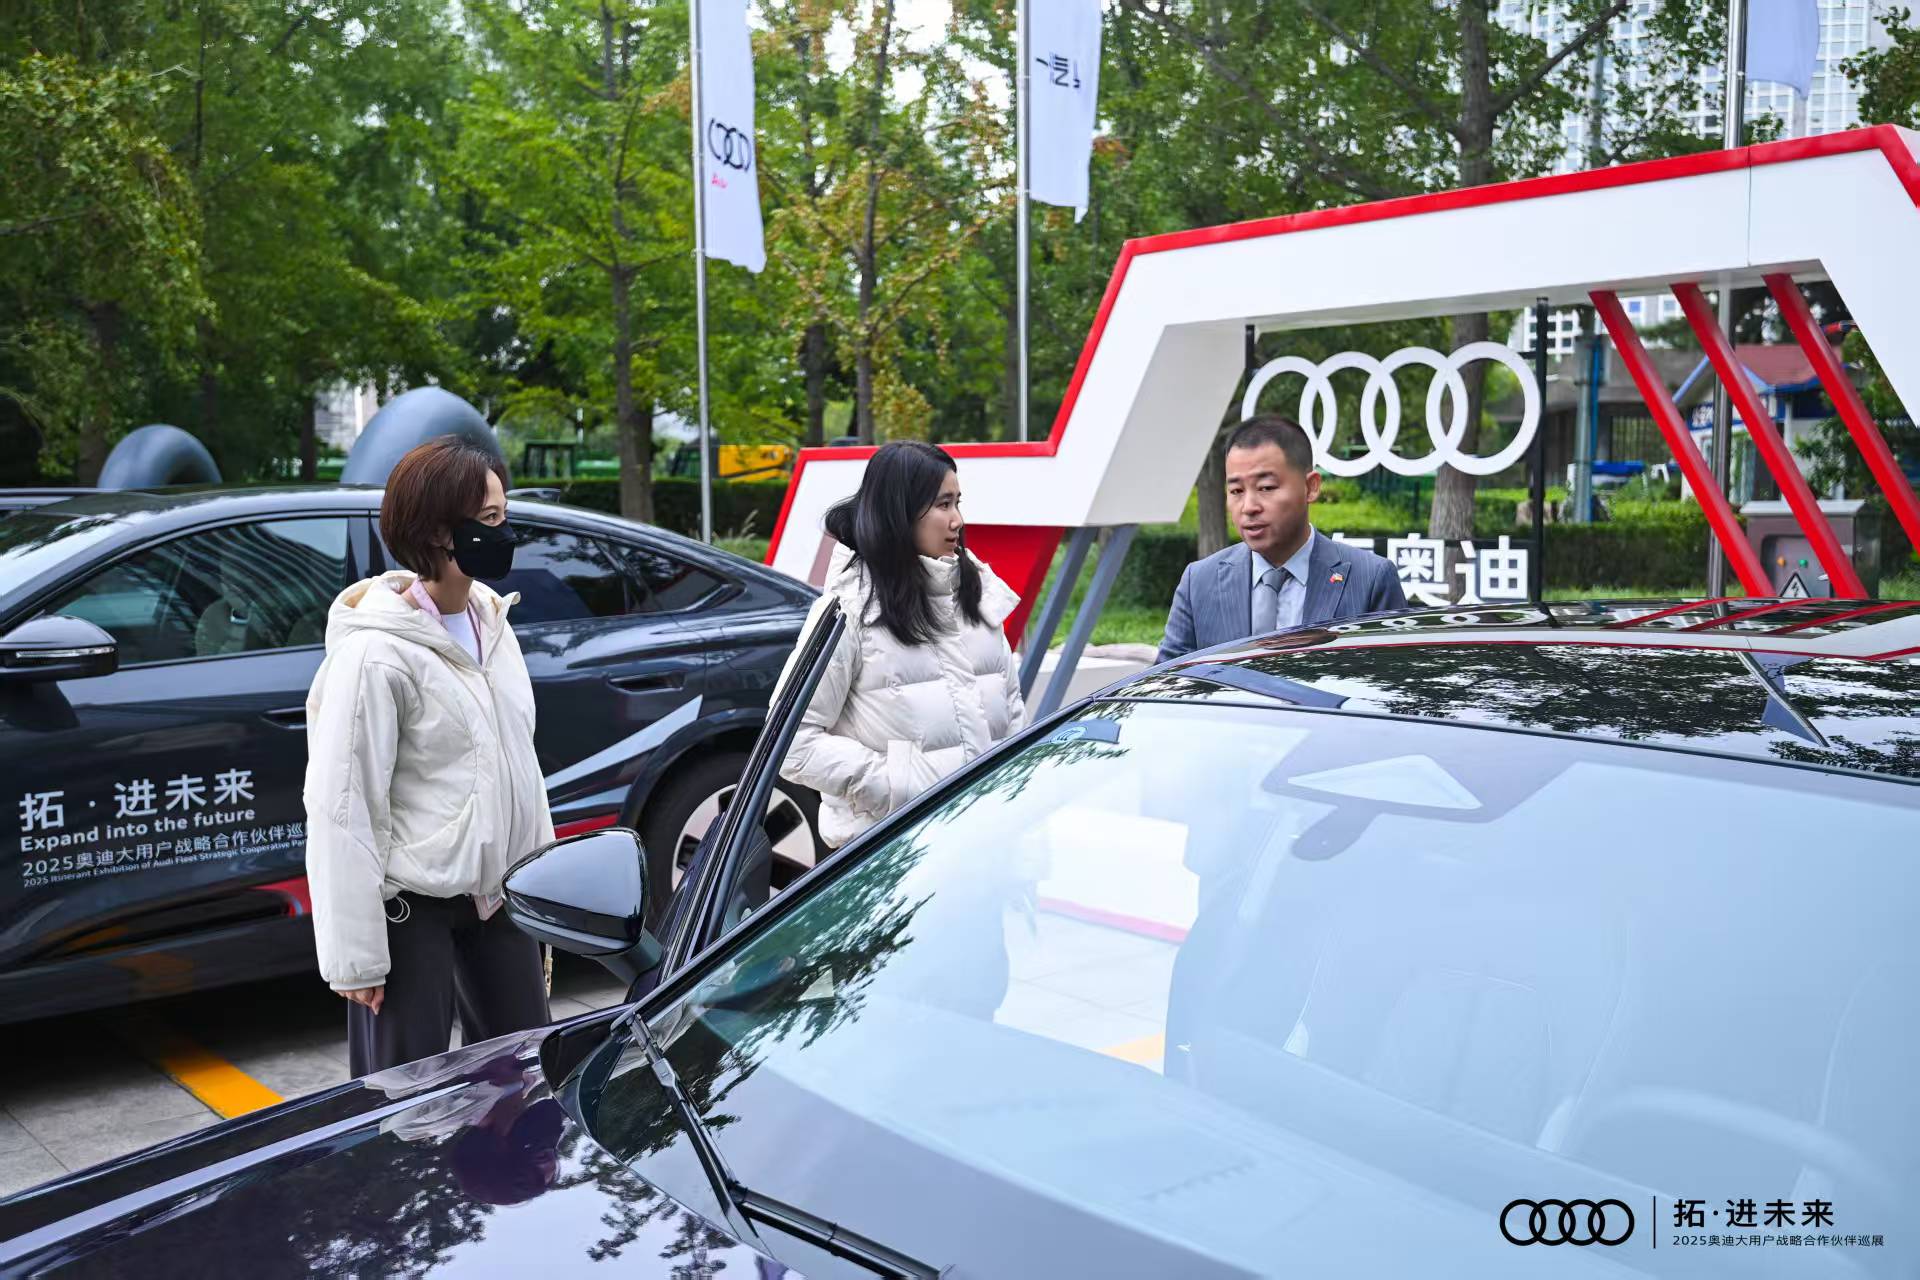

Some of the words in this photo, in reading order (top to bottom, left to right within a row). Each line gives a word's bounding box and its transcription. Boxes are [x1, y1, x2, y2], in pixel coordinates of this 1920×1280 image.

[1332, 532, 1528, 606] 奥迪
[21, 826, 99, 853] Expand
[106, 823, 148, 839] into
[154, 816, 188, 833] the
[194, 808, 256, 827] future
[23, 822, 307, 877] 2025奥迪大用户战略合作伙伴巡
[24, 876, 49, 888] 2025
[93, 864, 139, 876] Exhibition
[141, 861, 151, 870] of
[153, 858, 173, 869] Audi
[175, 854, 198, 865] Fleet
[199, 849, 238, 861] Strategic
[240, 840, 290, 854] Cooperative
